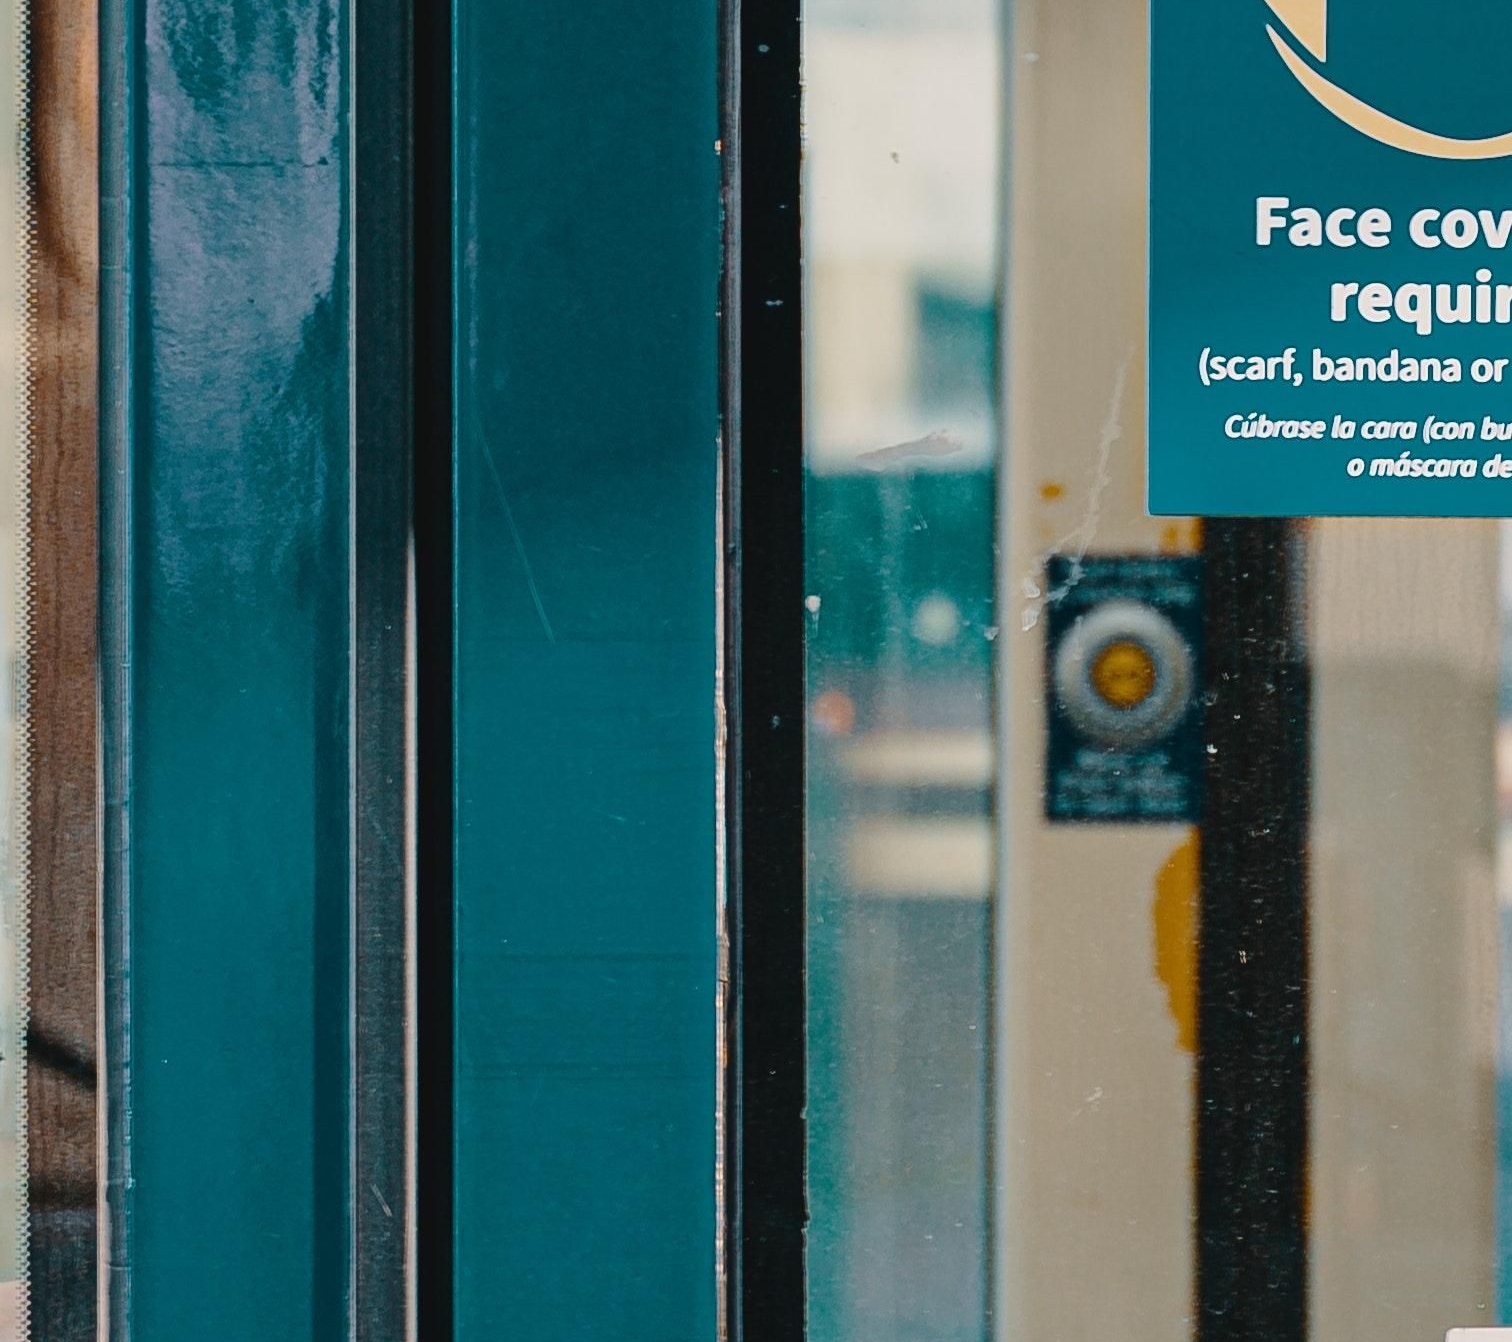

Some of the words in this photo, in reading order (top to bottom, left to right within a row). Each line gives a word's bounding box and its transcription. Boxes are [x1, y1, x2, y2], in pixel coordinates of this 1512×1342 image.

[1257, 197, 1391, 247] Face
[1199, 347, 1302, 386] (scarf,
[1313, 349, 1461, 382] bandana
[1471, 358, 1508, 382] or
[1225, 413, 1326, 439] Cúbrase
[1331, 415, 1355, 439] la
[1361, 421, 1417, 439] cara
[1423, 416, 1475, 443] (con
[1347, 458, 1364, 476] o
[1370, 451, 1476, 477] máscara
